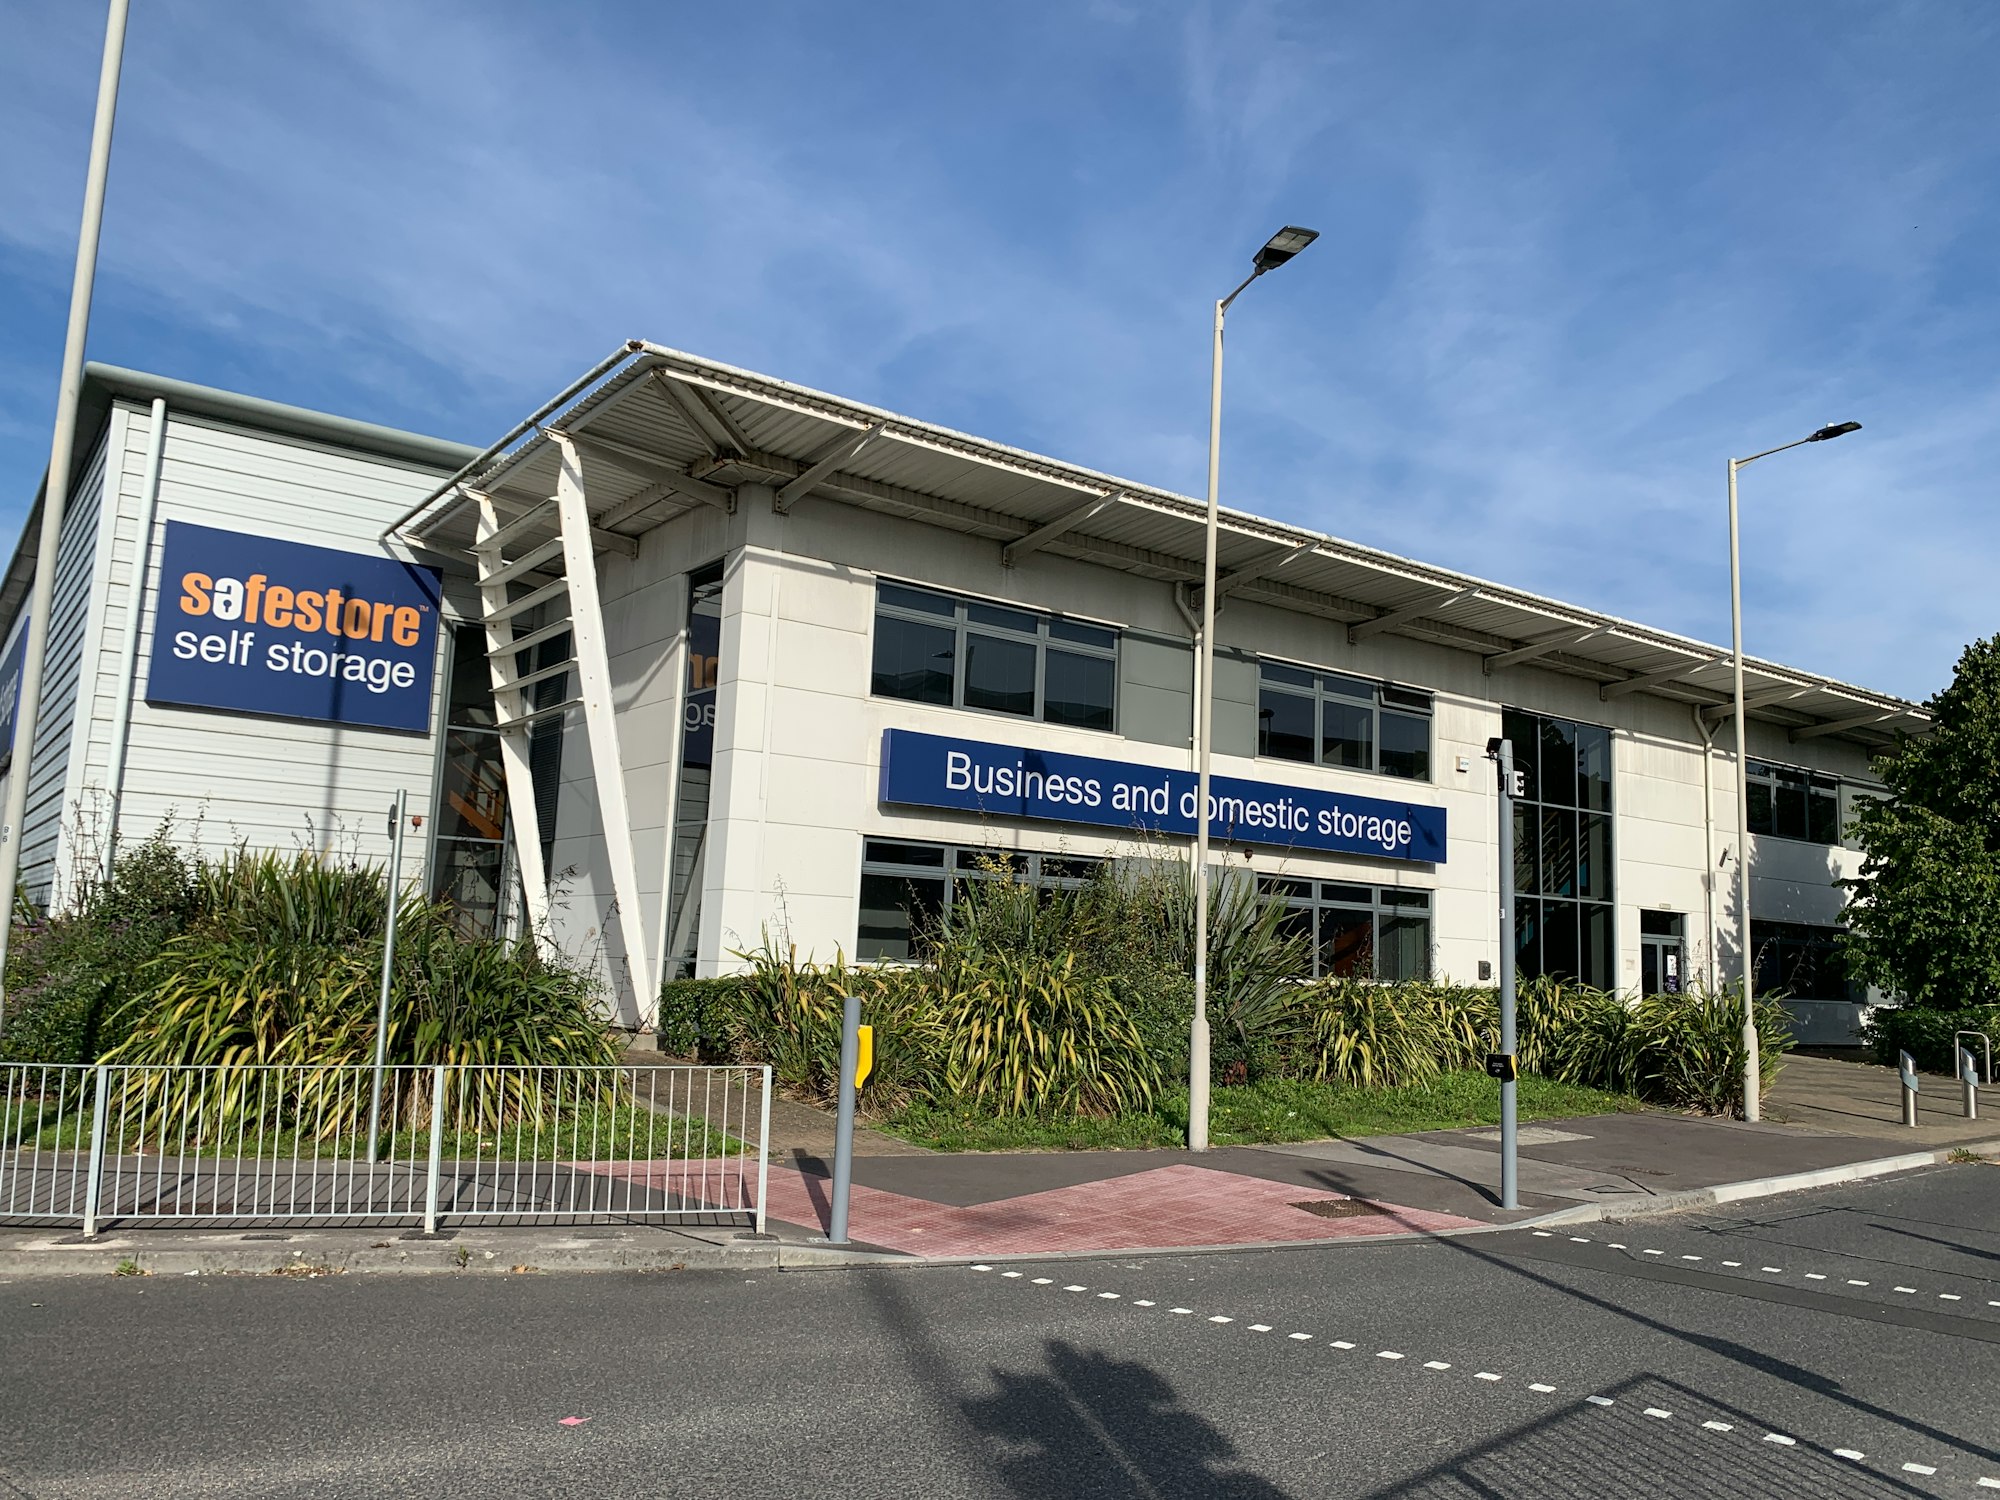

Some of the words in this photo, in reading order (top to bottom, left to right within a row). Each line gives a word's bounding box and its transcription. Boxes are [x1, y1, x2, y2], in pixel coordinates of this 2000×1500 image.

[180, 572, 421, 647] safestore
[173, 629, 255, 666] self
[266, 641, 416, 693] storage
[945, 751, 1102, 807] Business
[1111, 780, 1169, 816] and
[1317, 805, 1412, 851] storage
